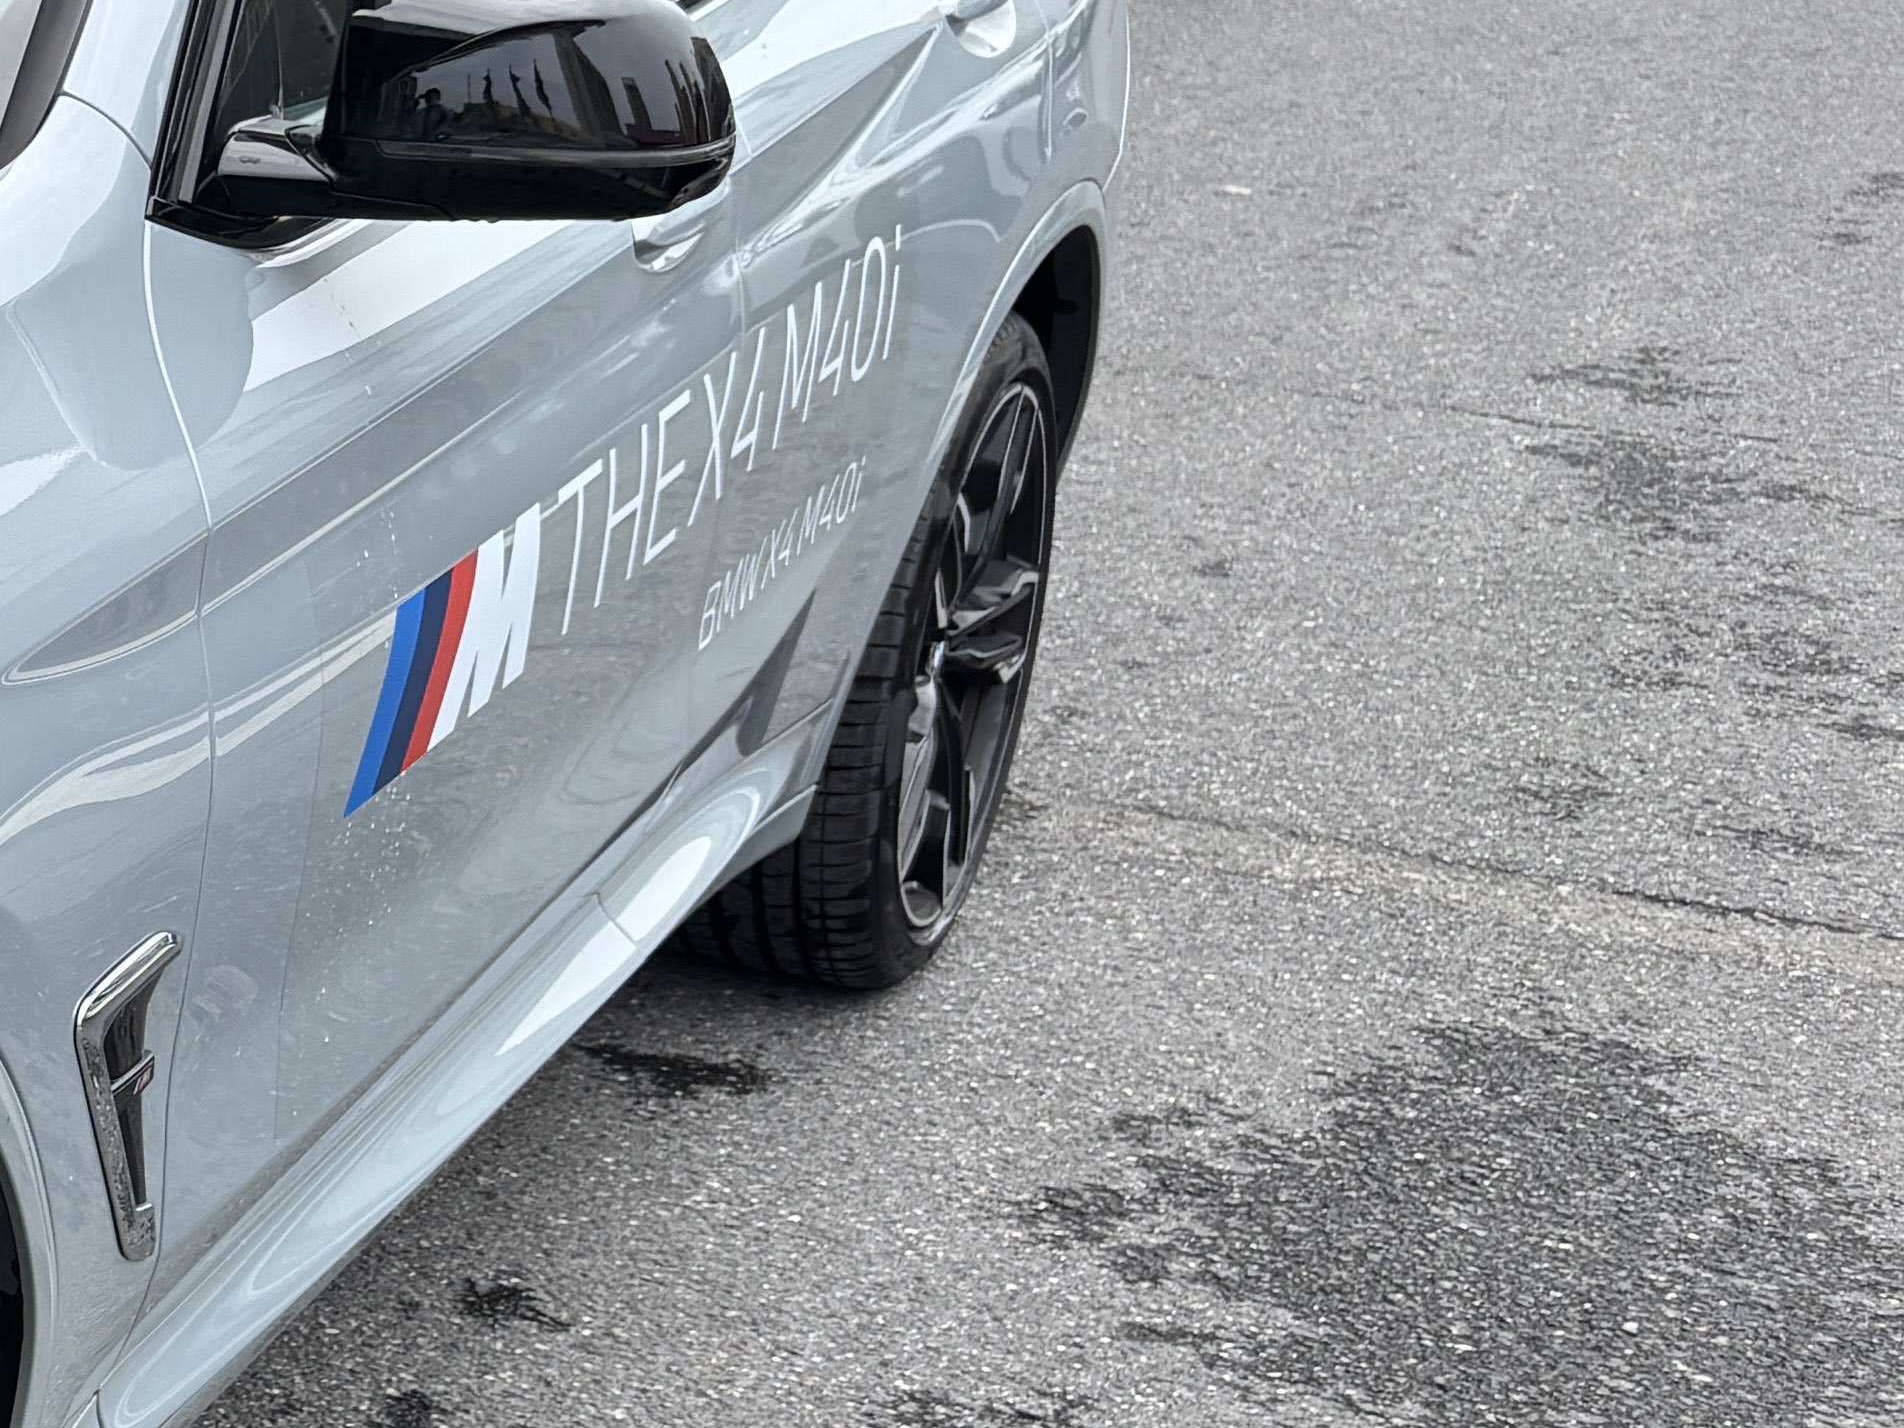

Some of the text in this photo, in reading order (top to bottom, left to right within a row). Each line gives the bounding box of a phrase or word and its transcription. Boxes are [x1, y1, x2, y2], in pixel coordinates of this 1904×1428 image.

[558, 389, 690, 635] THE
[687, 326, 766, 527] X4
[772, 223, 902, 450] M40i
[698, 455, 867, 652] BMW X4 M40i
